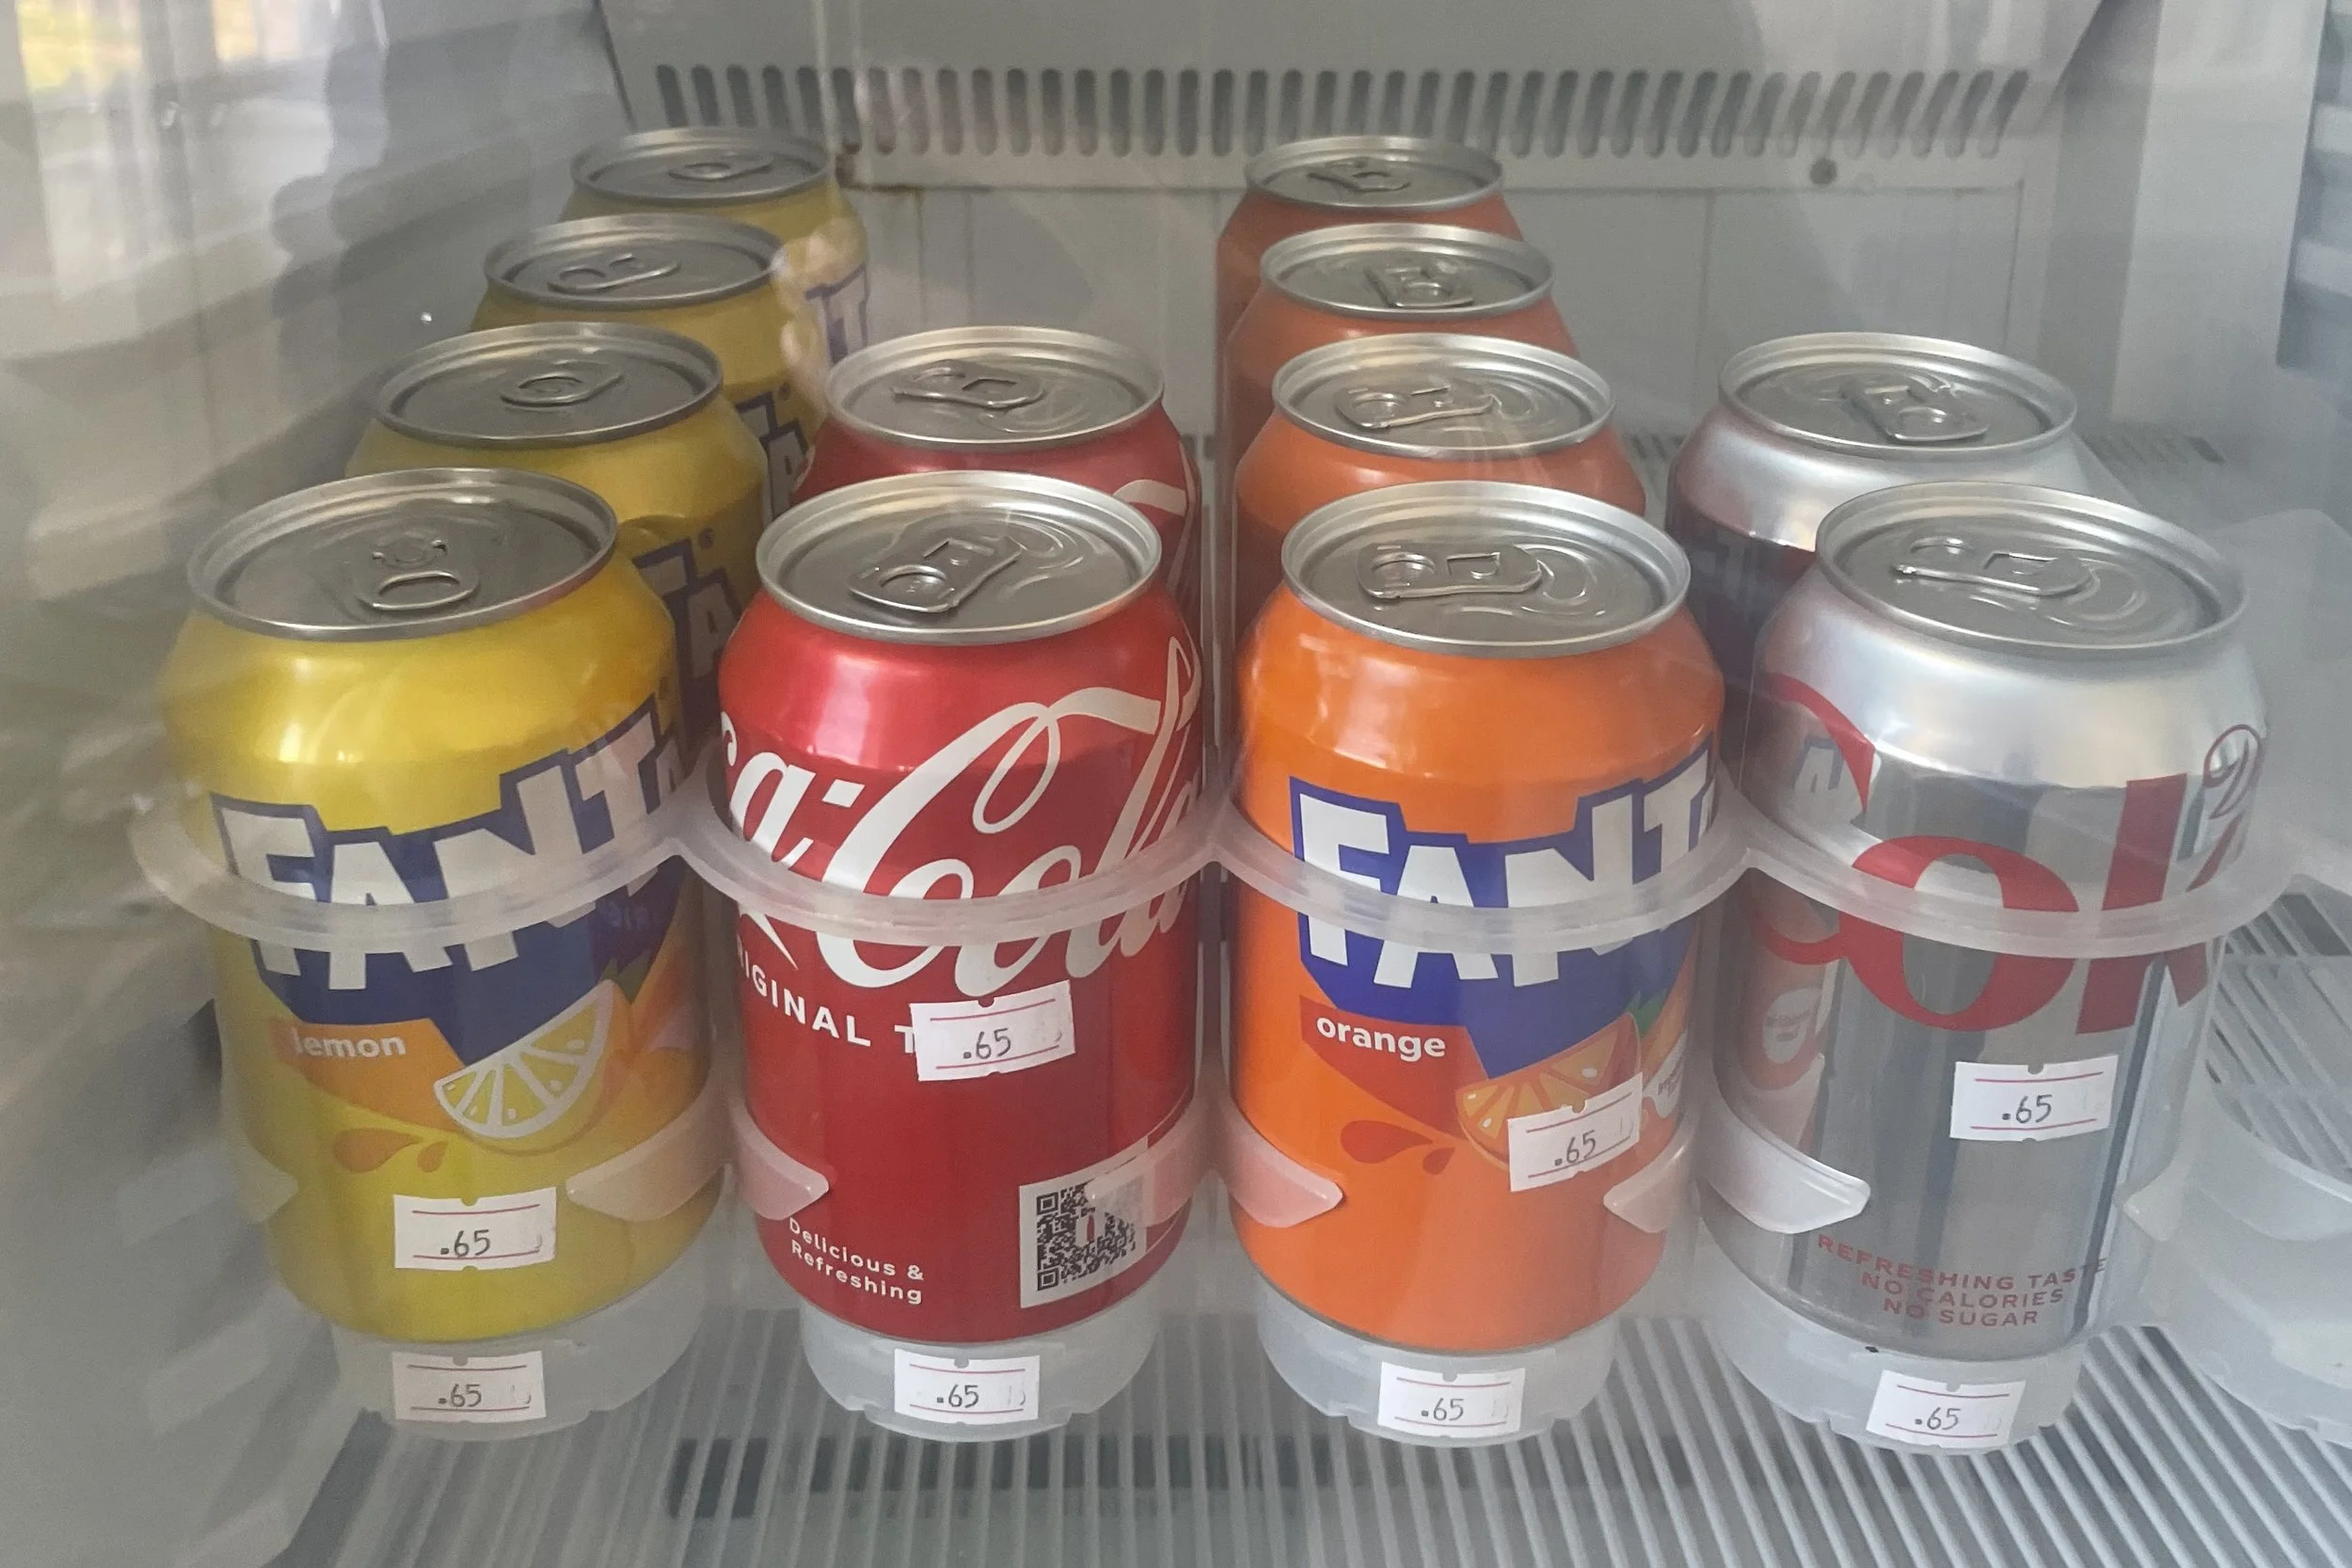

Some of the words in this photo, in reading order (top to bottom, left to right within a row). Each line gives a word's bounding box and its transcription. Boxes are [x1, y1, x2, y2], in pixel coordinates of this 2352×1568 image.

[1300, 748, 1716, 989] FANT
[290, 1026, 406, 1057] lemon
[962, 1027, 1012, 1060] .65
[1317, 1016, 1447, 1062] orange
[2003, 1094, 2053, 1124] .65
[1554, 1130, 1597, 1166] .65
[439, 1228, 492, 1258] .65
[789, 1217, 897, 1276] Delicious
[907, 1264, 924, 1280] &
[791, 1239, 923, 1305] Refreshing
[1817, 1233, 2014, 1290] REFRESHING
[1861, 1272, 1903, 1295] NO
[1917, 1288, 2065, 1308] CALORIES
[1883, 1298, 1926, 1319] NO
[1939, 1309, 2039, 1327] SUGAR
[437, 1384, 483, 1408] .65
[936, 1385, 979, 1408] .65
[1421, 1398, 1465, 1422] .65
[1914, 1407, 1962, 1431] .65
